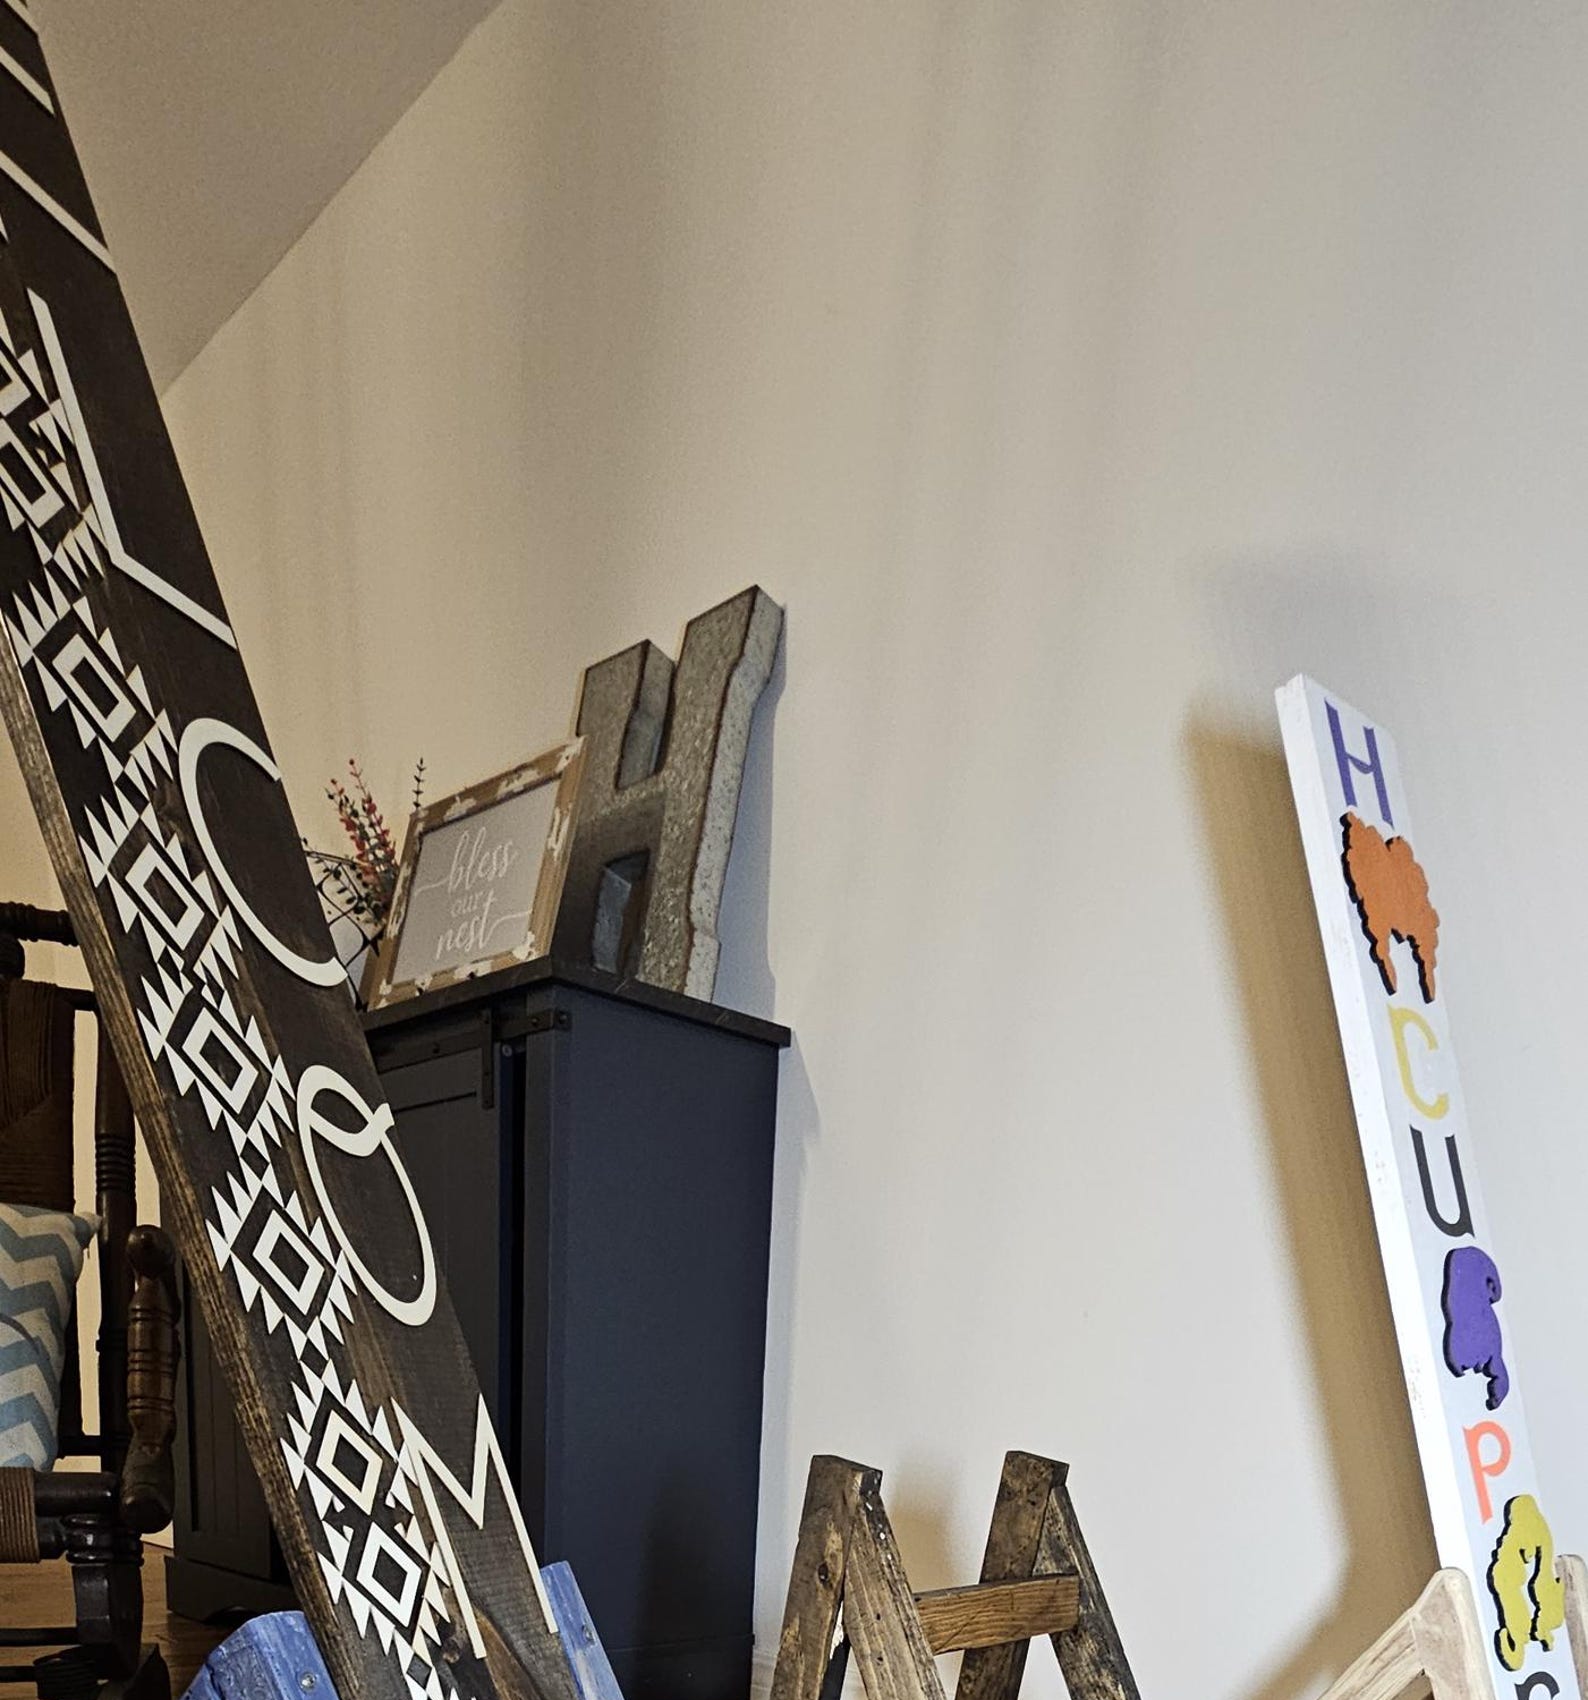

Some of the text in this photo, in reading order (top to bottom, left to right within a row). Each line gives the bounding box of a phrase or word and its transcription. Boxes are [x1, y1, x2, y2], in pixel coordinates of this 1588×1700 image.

[414, 826, 519, 896] bless
[435, 888, 533, 961] nest
[451, 890, 484, 917] our
